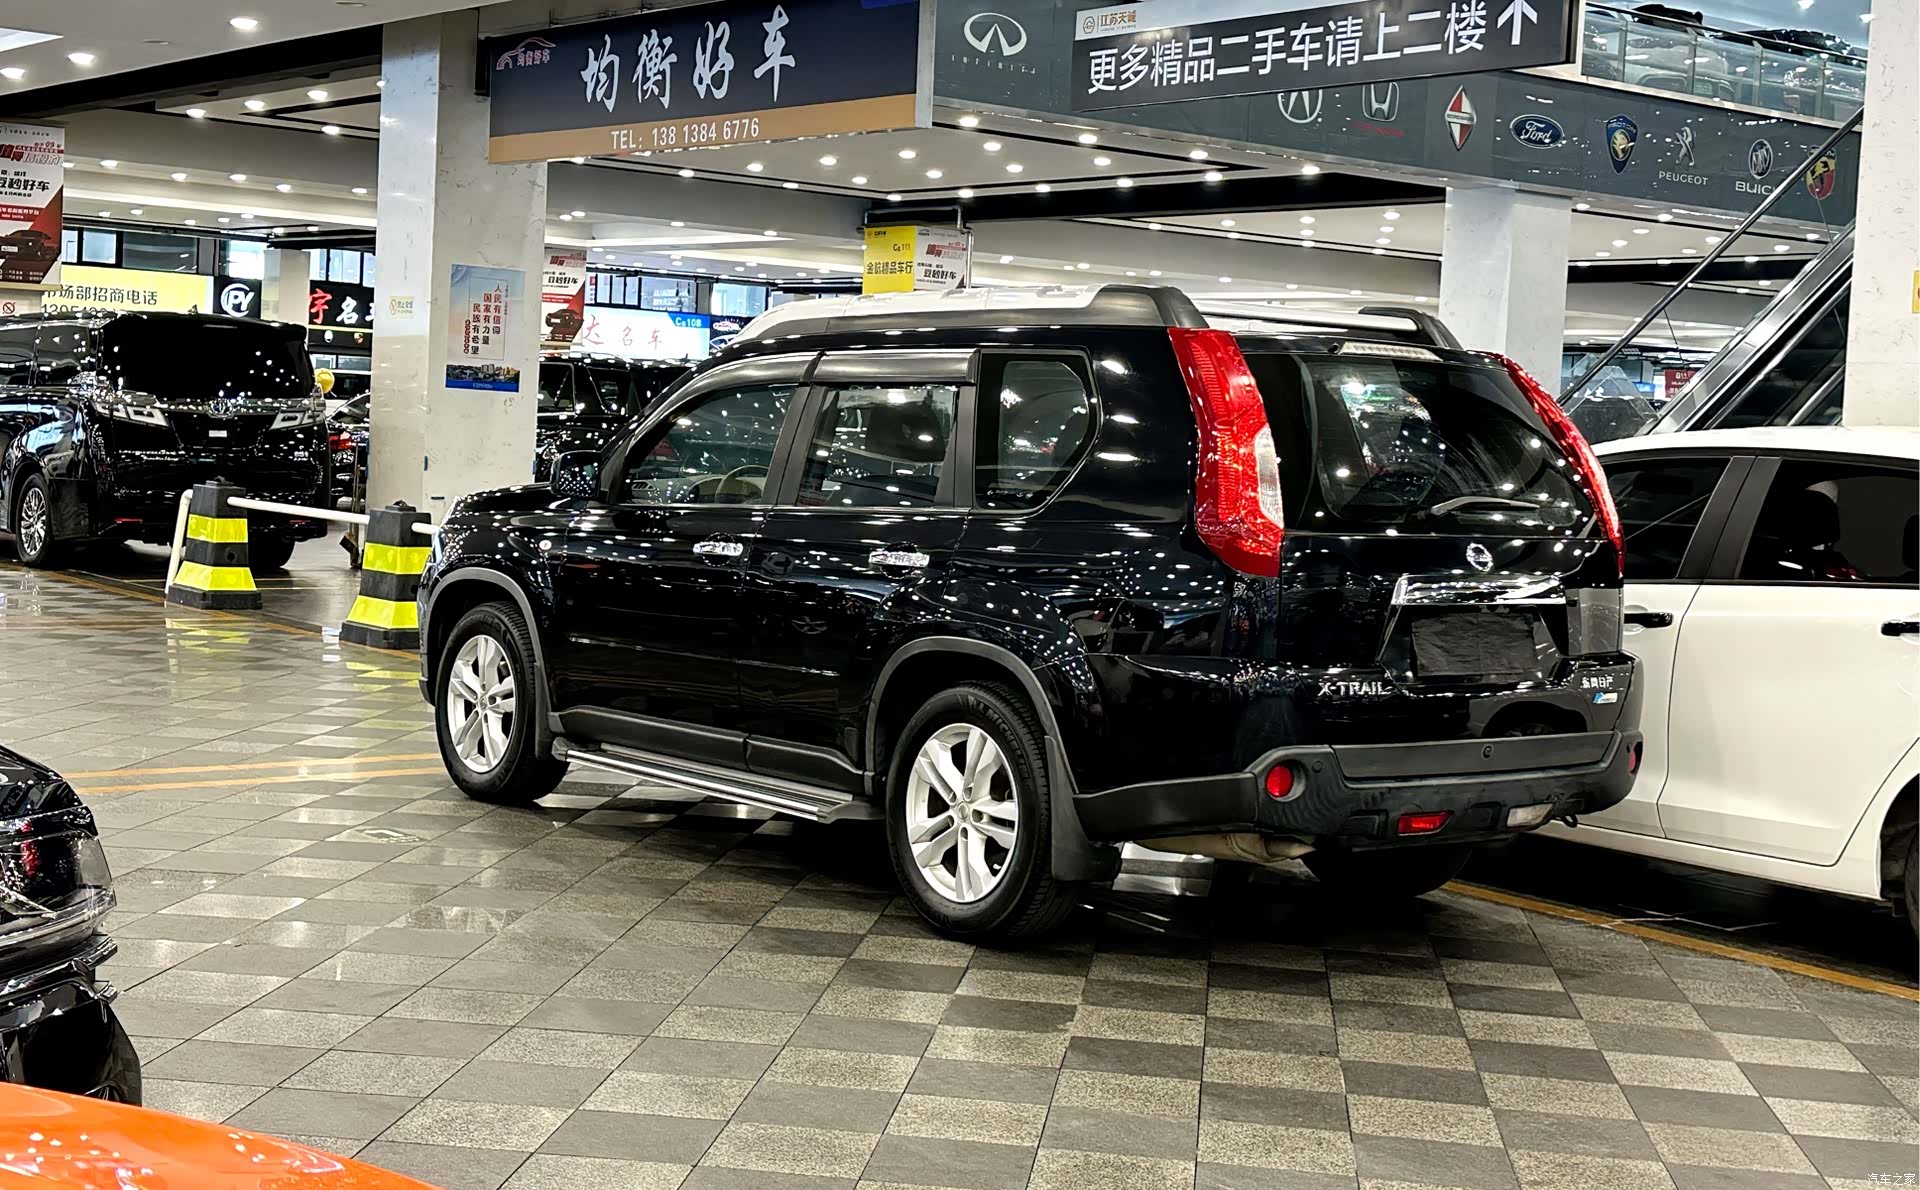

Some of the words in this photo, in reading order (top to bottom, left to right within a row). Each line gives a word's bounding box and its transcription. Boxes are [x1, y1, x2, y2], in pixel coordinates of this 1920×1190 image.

[580, 4, 796, 113] 均衡好车
[1087, 0, 1487, 94] 更多精品二手车请上二楼
[652, 126, 676, 147] 138
[683, 122, 717, 144] 1384
[723, 117, 759, 140] 6776
[1521, 120, 1552, 143] Ford
[1658, 170, 1709, 186] PEUGEOT
[1735, 181, 1777, 196] BUIC
[470, 302, 481, 355] 民族有希望
[482, 292, 492, 345] 国家有力量
[493, 282, 502, 335] 人民有信仰
[1317, 681, 1392, 696] X-TRAIL
